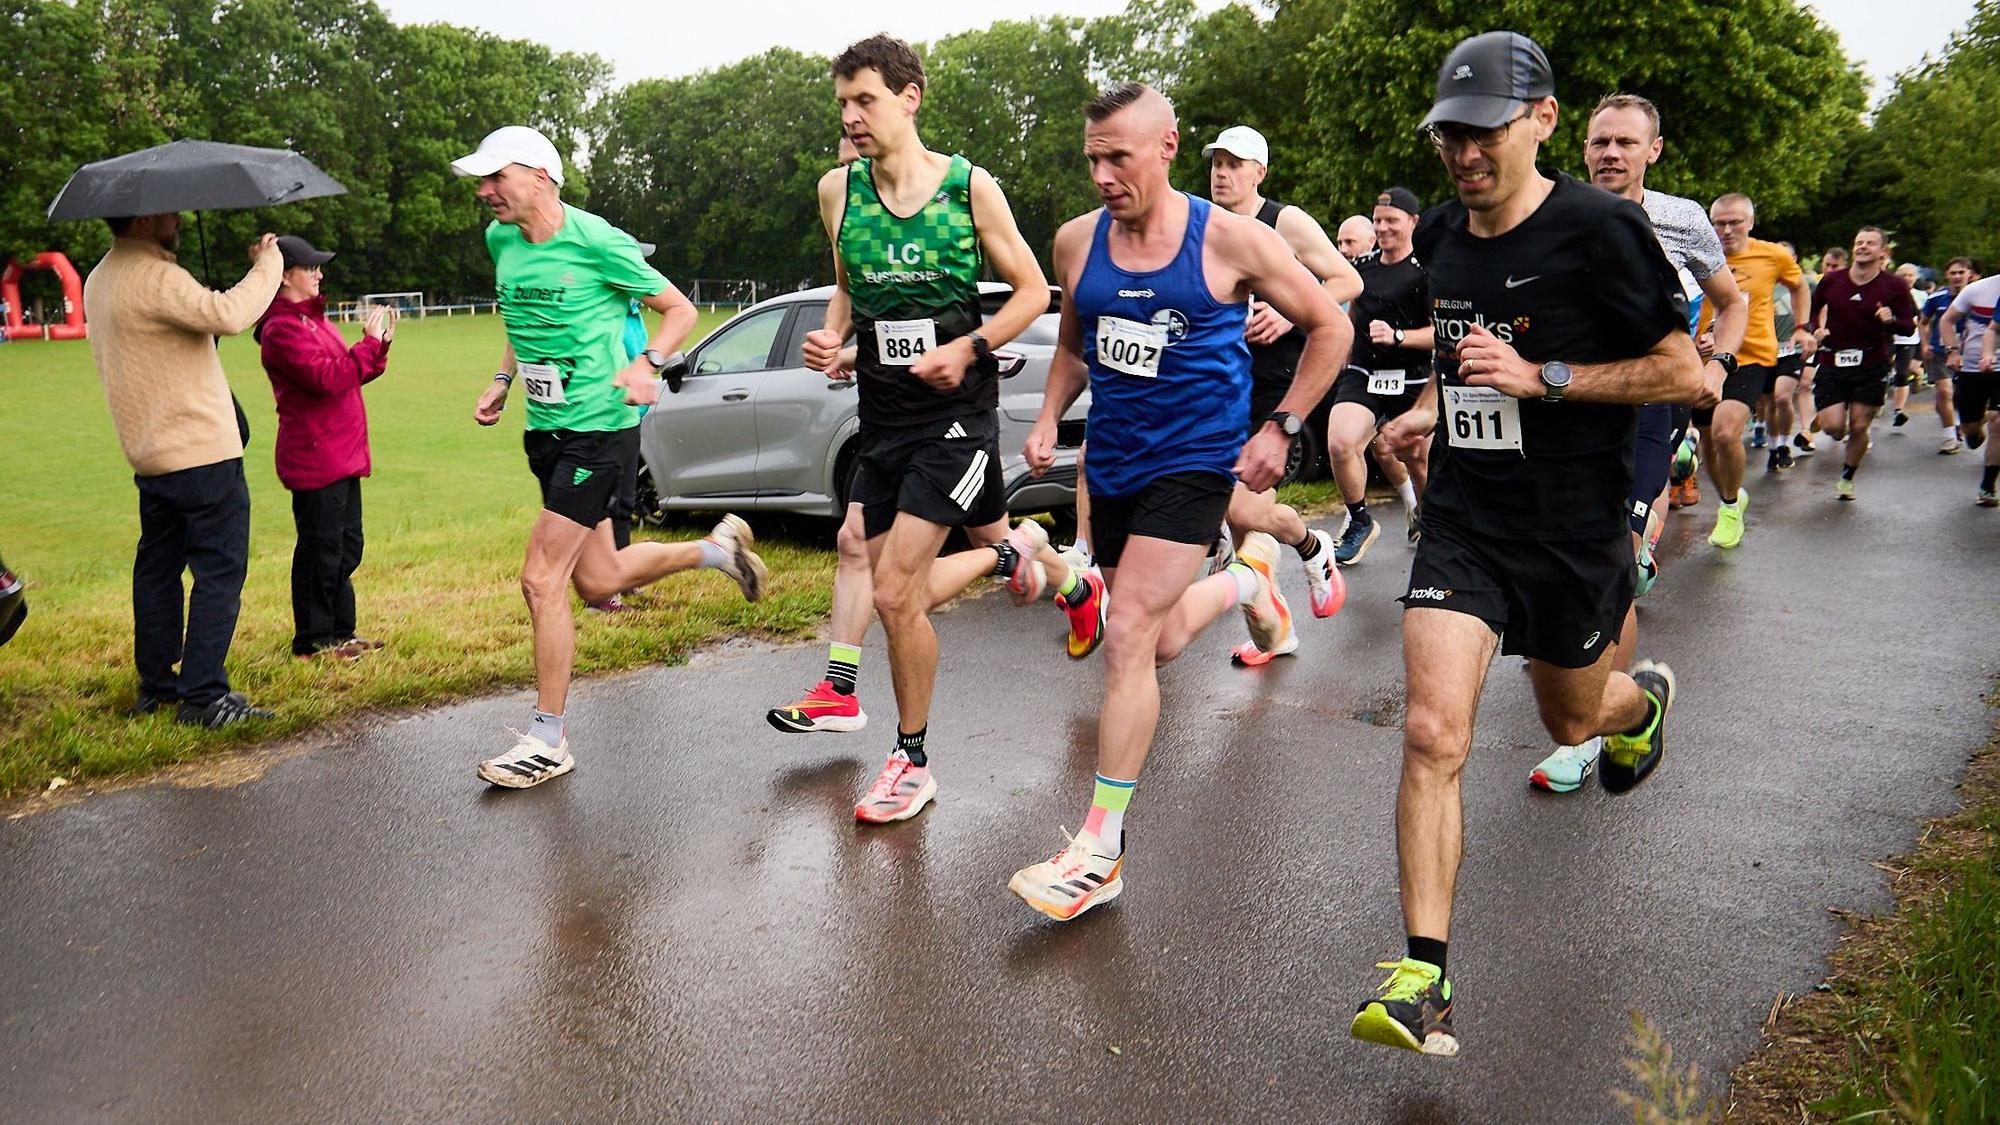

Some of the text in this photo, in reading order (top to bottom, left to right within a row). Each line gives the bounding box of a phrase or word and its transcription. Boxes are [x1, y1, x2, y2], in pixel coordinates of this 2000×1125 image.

[887, 242, 920, 265] LC
[886, 337, 926, 358] 884
[1101, 335, 1158, 367] 1007
[1375, 379, 1399, 390] 613
[1455, 410, 1503, 440] 611
